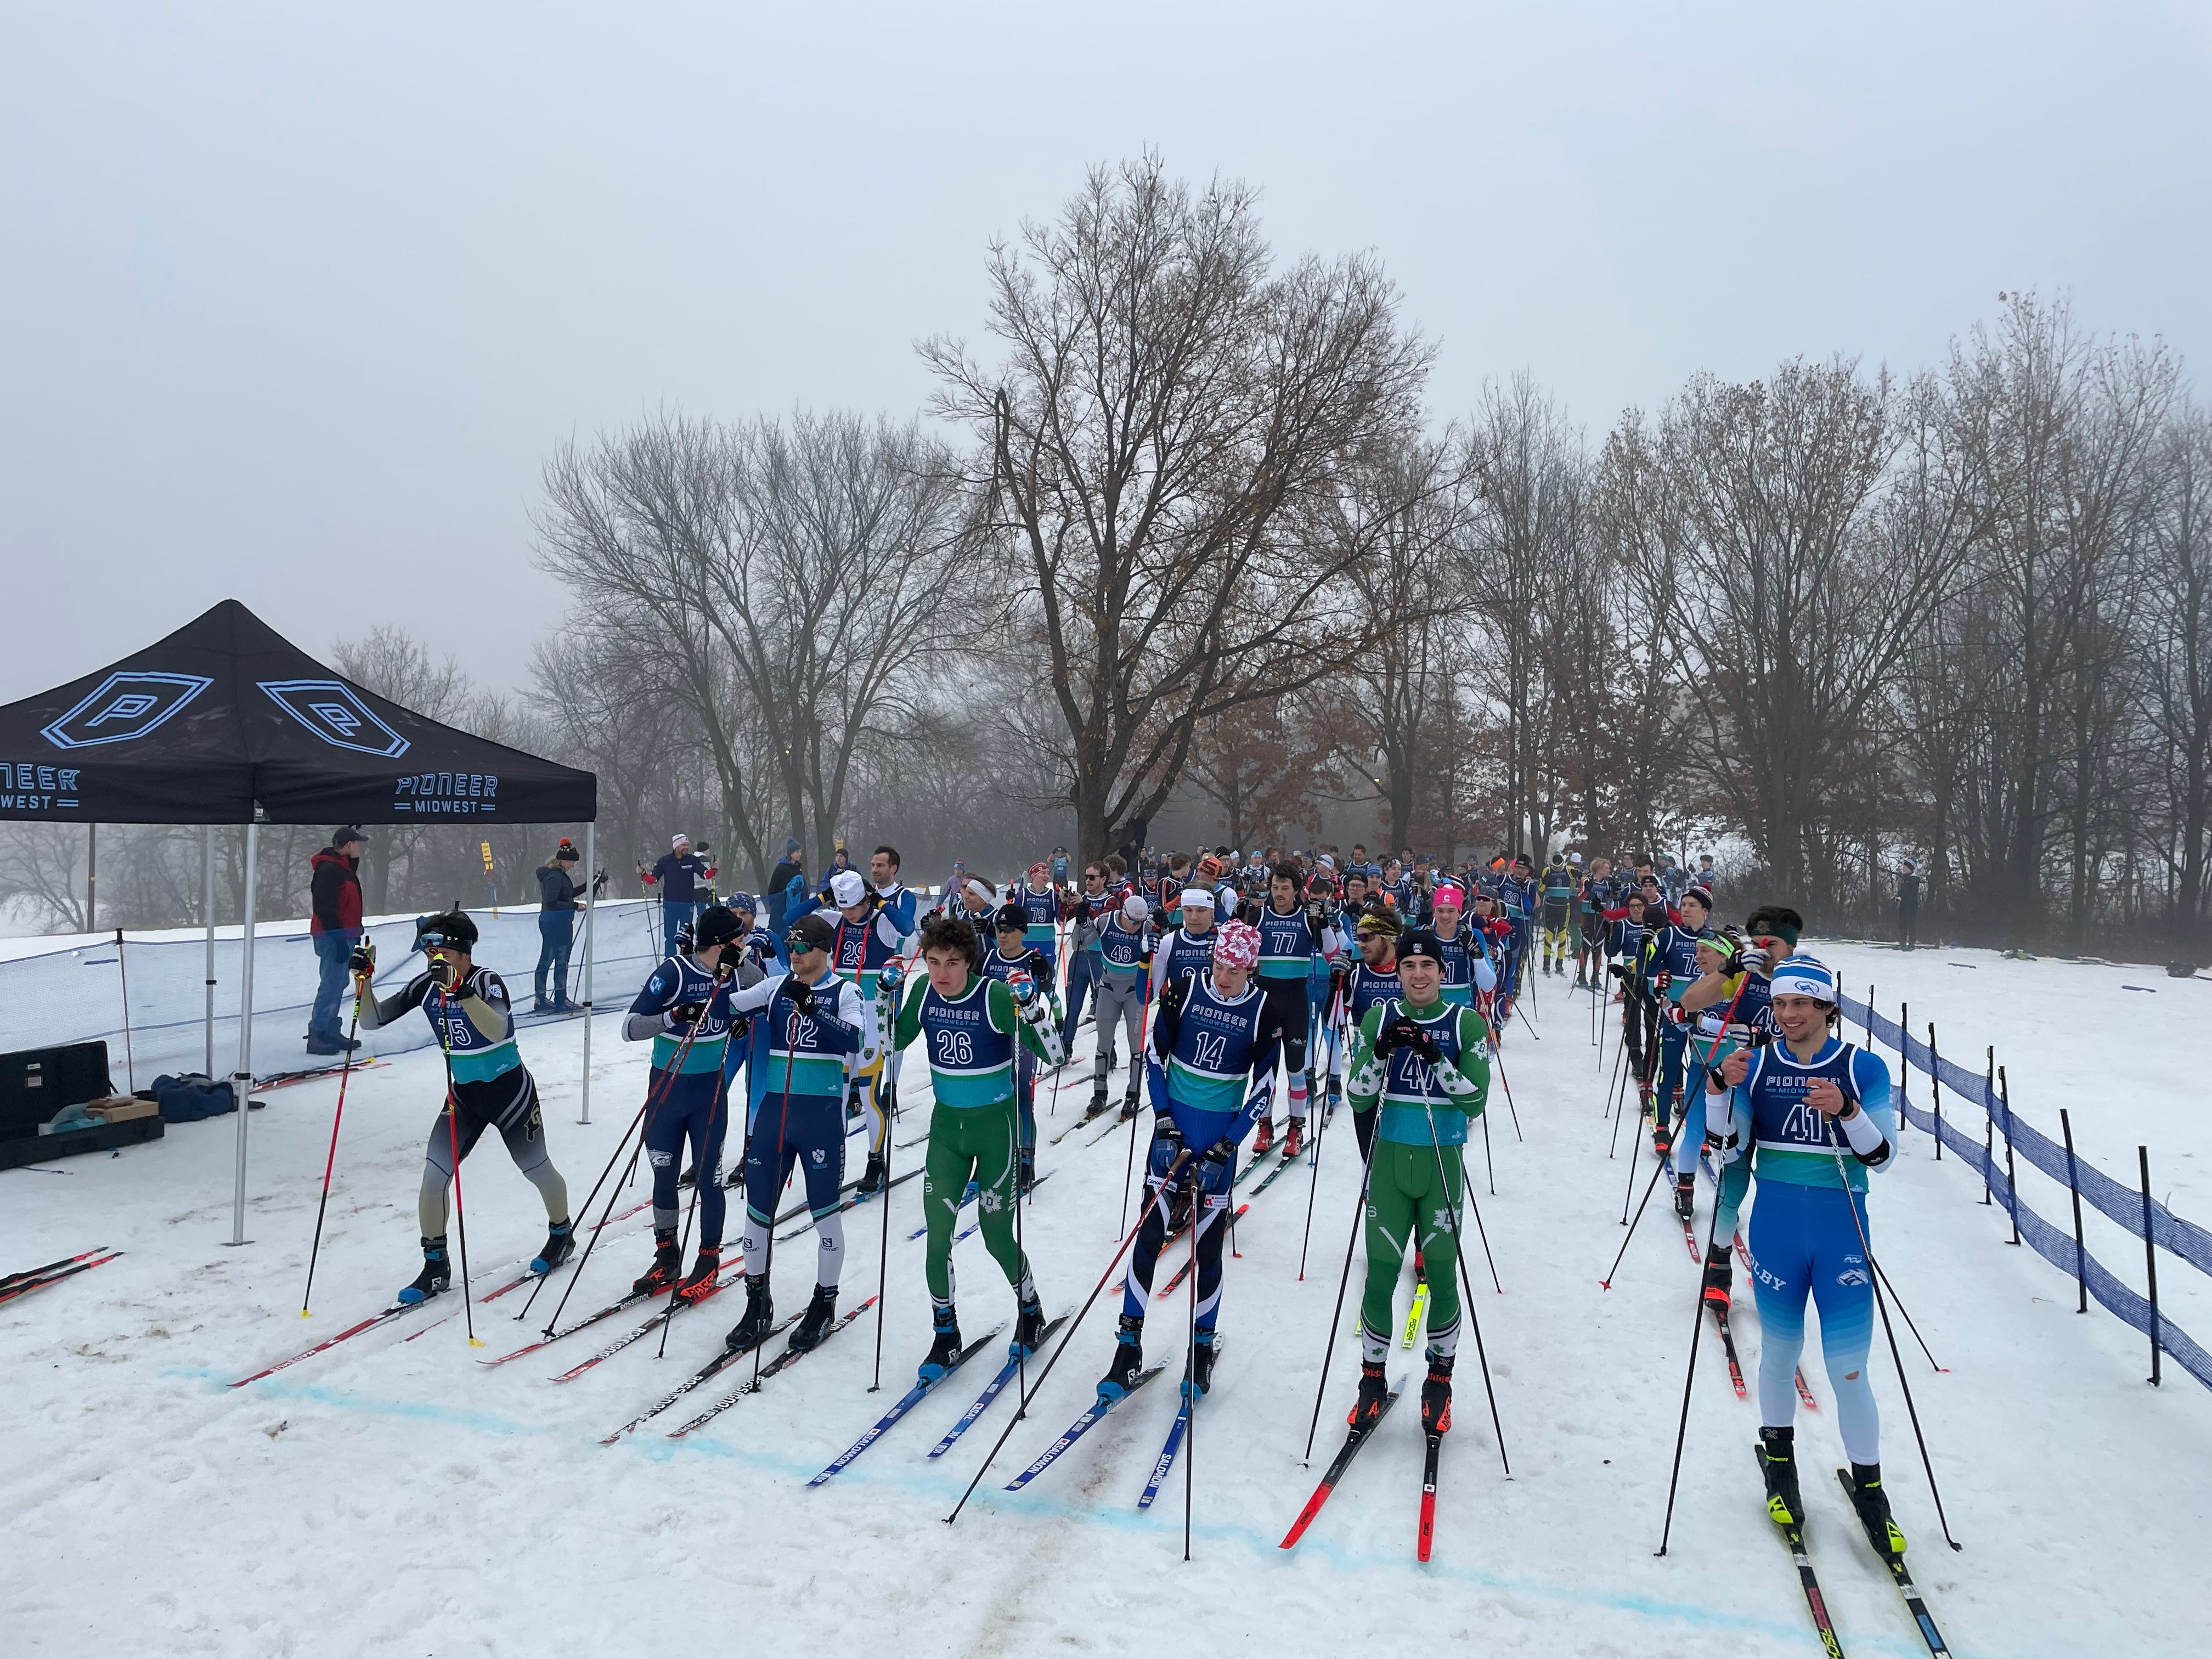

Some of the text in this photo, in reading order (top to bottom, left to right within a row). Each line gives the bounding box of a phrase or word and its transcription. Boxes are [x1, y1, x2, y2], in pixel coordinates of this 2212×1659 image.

[395, 772, 498, 797] PIONEER
[415, 800, 477, 812] MIDWEST
[1556, 878, 1562, 887] 2
[1503, 890, 1519, 905] 59
[1030, 907, 1046, 923] 79
[1108, 931, 1138, 940] PIONEER
[1272, 932, 1297, 953] 77
[842, 941, 866, 965] 29
[1110, 945, 1131, 962] 46
[817, 1008, 852, 1032] PIONEER
[928, 1006, 979, 1020] PIONEER
[936, 1018, 968, 1026] MIDWEST
[1192, 1005, 1248, 1028] PIONEER
[1200, 1017, 1234, 1030] MIDWEST
[786, 1013, 819, 1048] 82
[936, 1029, 973, 1065] 26
[1193, 1031, 1226, 1070] 14
[1782, 1104, 1821, 1142] 41
[619, 1293, 650, 1311] ROSSIGNOL
[1404, 1318, 1417, 1341] FISCHER
[721, 1350, 743, 1368] ROSSIGNOL
[834, 1434, 874, 1466] SALOMON
[1027, 1443, 1065, 1474] SALOMON
[1148, 1453, 1172, 1488] SALOMON
